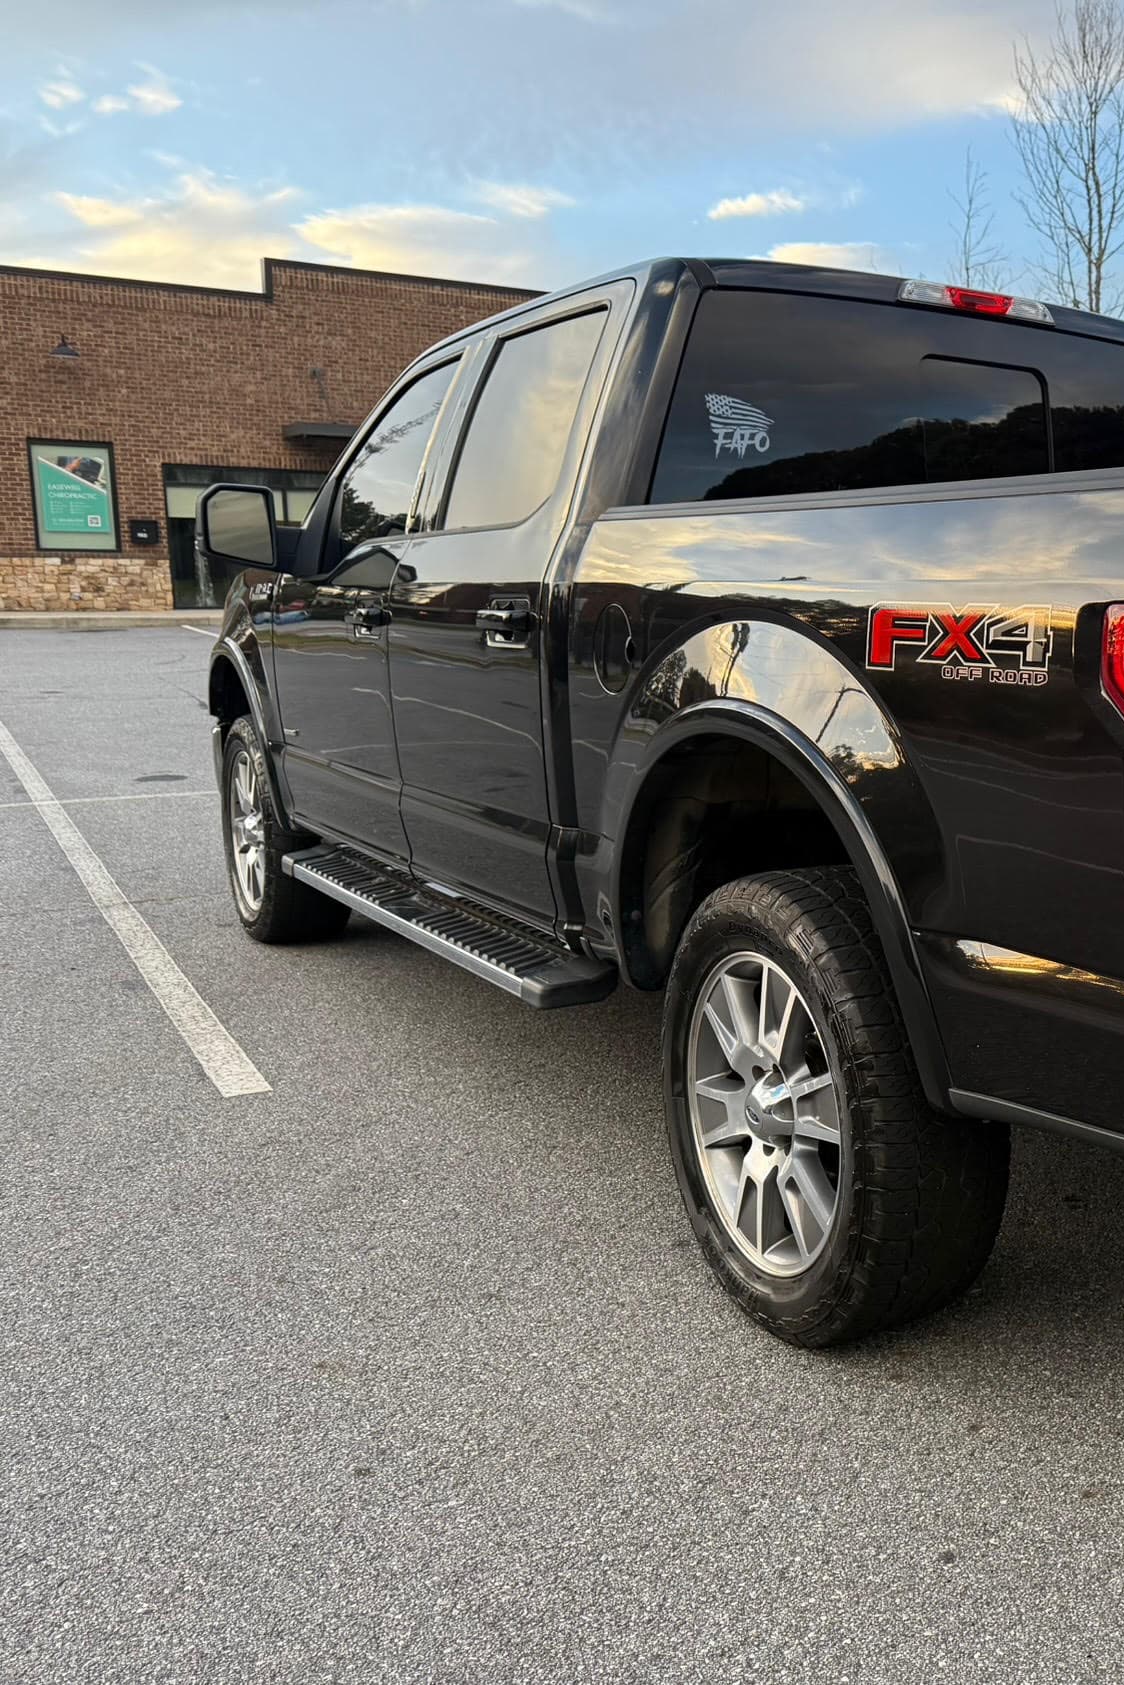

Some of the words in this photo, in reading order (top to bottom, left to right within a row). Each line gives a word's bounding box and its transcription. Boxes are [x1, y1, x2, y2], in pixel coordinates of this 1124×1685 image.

[711, 427, 770, 459] FAFO
[865, 601, 1054, 672] FX4
[941, 665, 983, 681] OFF
[988, 668, 1049, 686] ROAD
